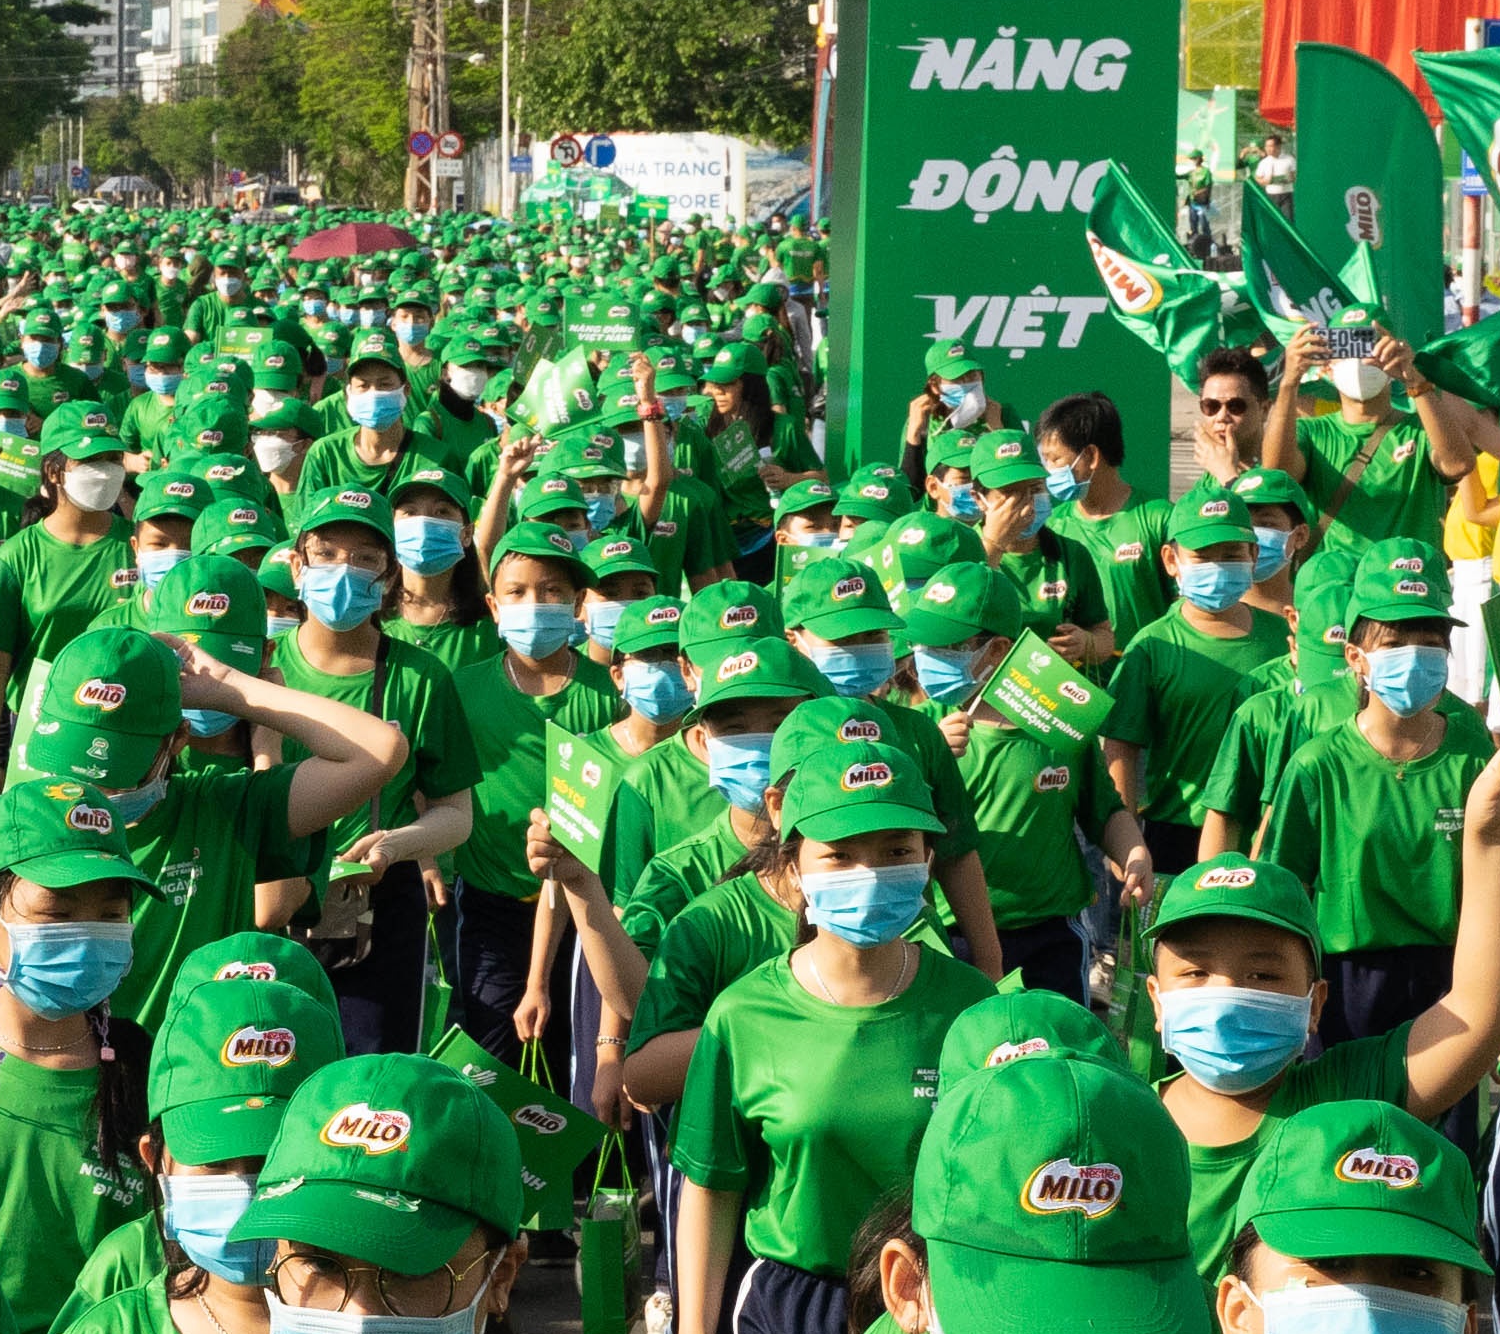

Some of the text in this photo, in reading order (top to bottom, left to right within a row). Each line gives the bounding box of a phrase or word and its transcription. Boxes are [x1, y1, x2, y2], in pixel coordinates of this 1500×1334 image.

[900, 26, 1132, 92] NĂNG
[653, 160, 722, 177] TRANG
[1358, 191, 1373, 240] MILO
[914, 284, 1108, 359] VIỆT
[233, 1035, 292, 1058] MILO
[331, 1117, 402, 1144] MILO
[1352, 1156, 1413, 1182] MILO
[1037, 1173, 1117, 1206] MILO
